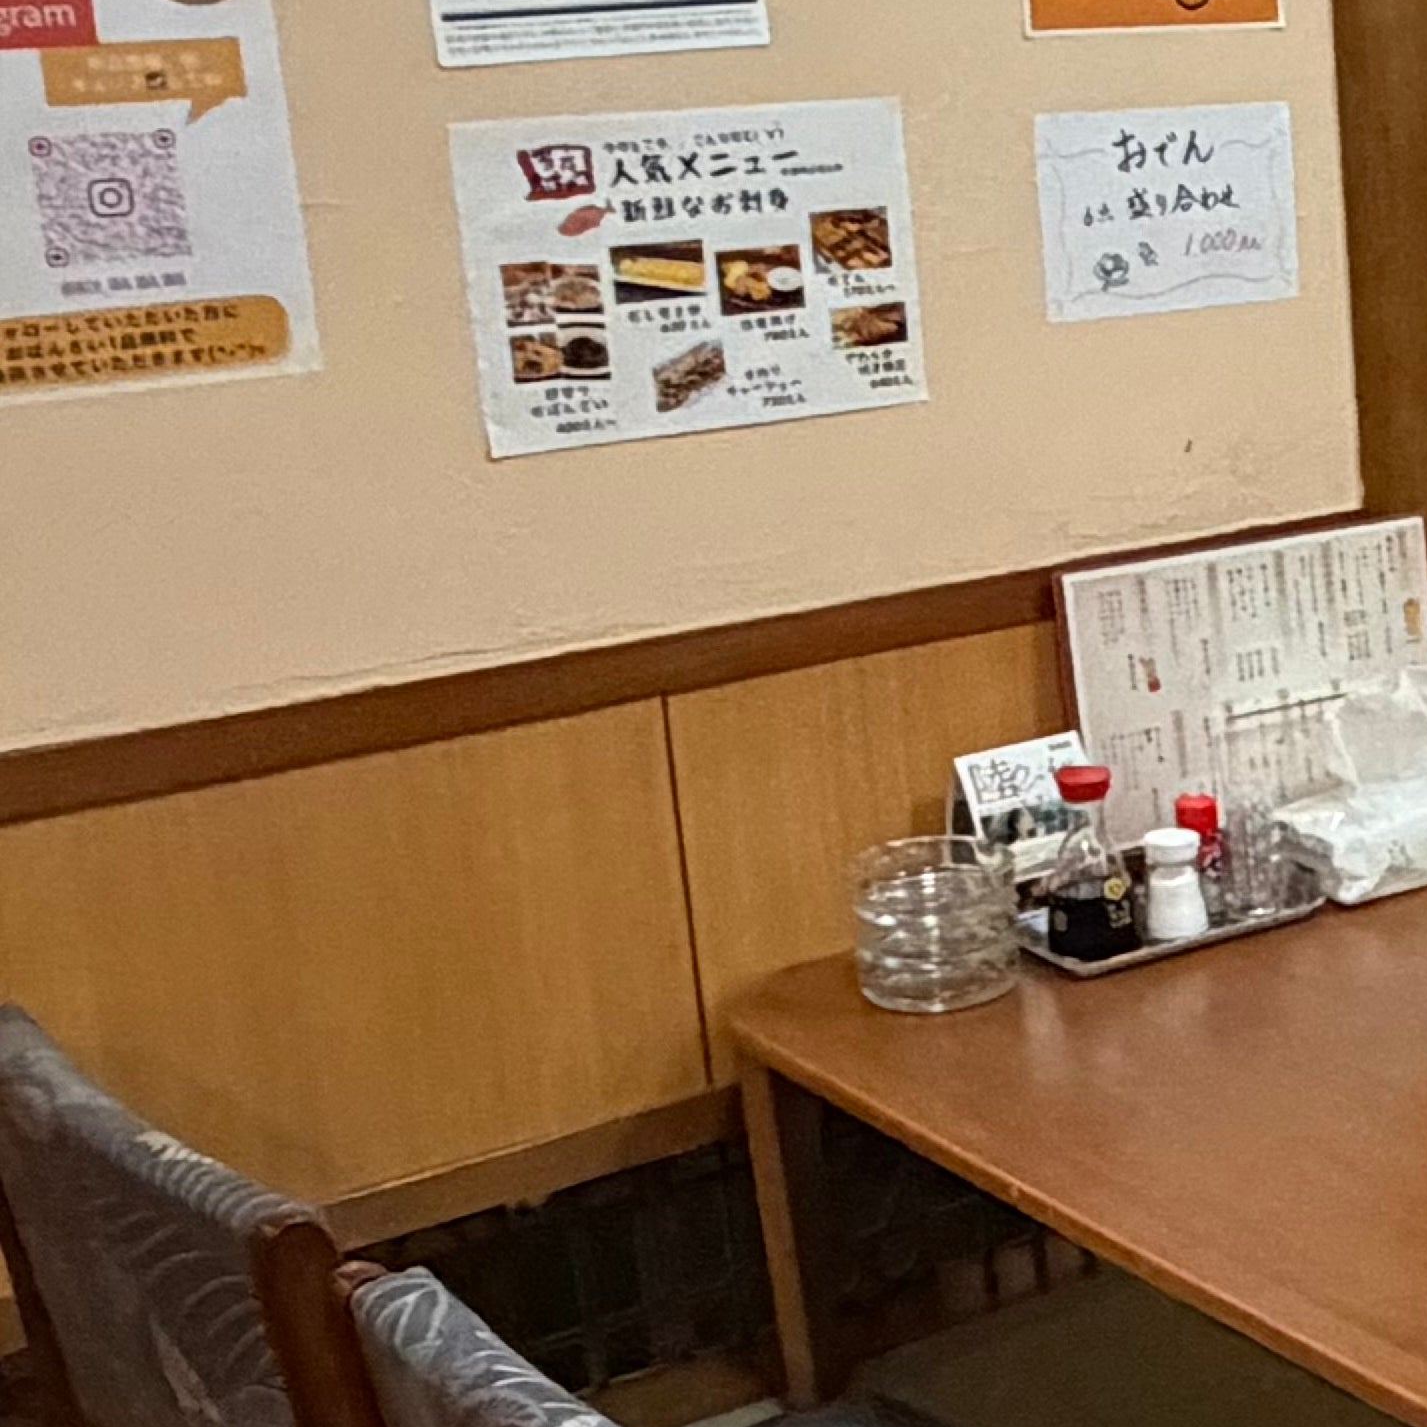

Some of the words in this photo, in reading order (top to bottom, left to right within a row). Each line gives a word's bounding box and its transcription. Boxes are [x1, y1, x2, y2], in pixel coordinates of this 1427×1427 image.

[610, 150, 799, 188] 人気メニュー
[1111, 127, 1215, 173] おでん
